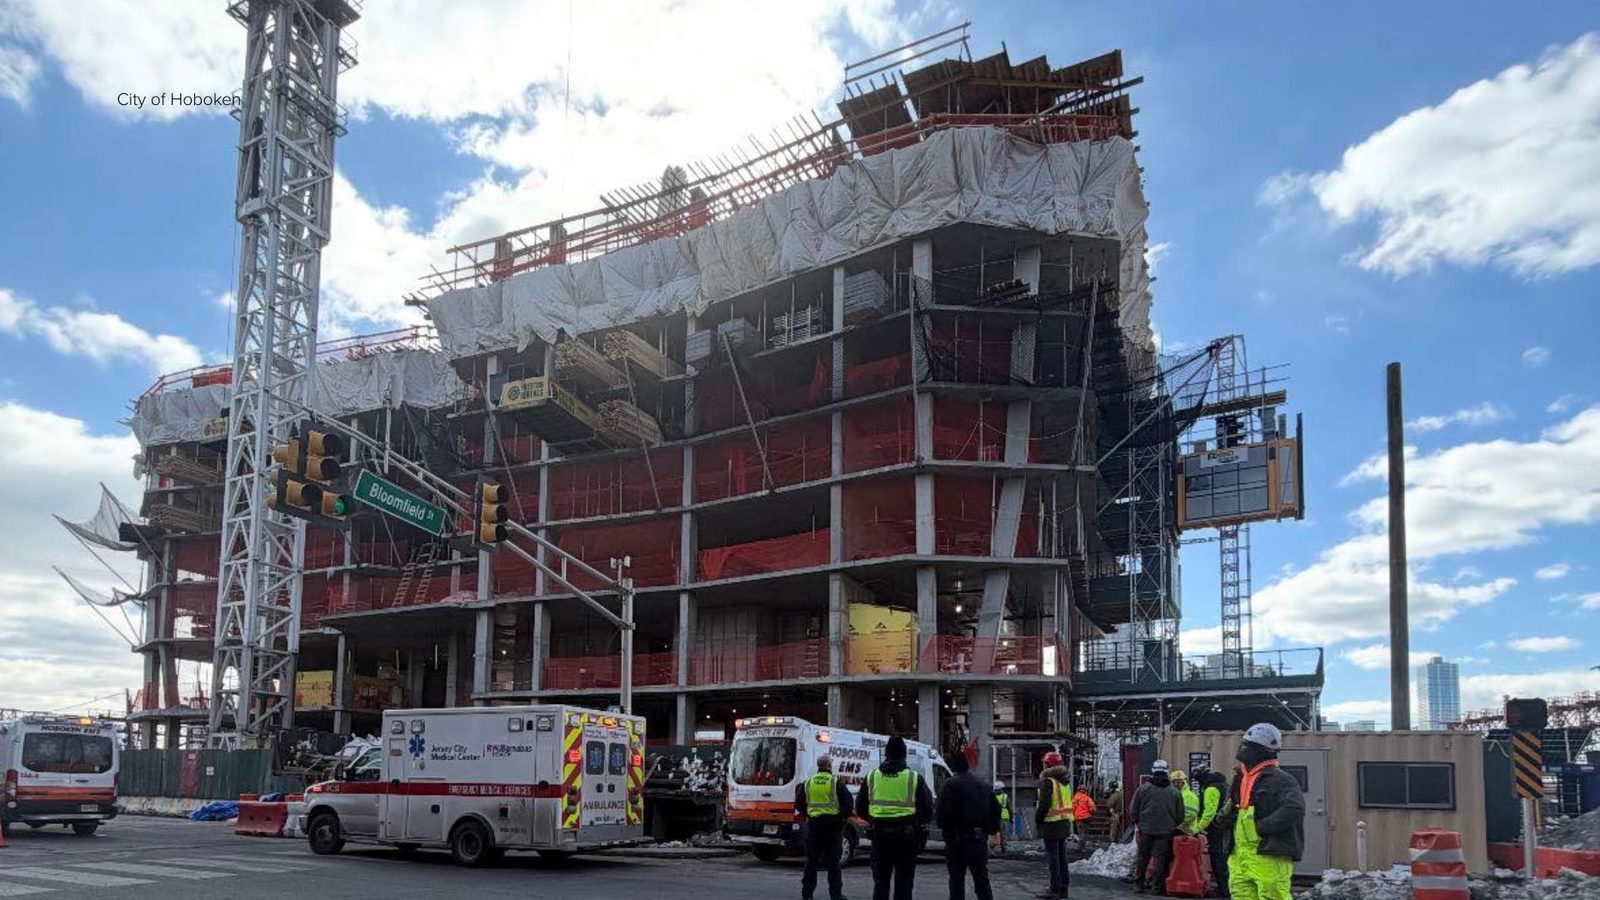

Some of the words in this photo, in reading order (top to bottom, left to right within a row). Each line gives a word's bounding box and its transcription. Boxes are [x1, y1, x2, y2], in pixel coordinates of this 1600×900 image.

[369, 482, 427, 520] Bloomfield
[431, 744, 453, 753] Jersey
[454, 744, 468, 753] City
[828, 745, 871, 761] HOBOKEN
[431, 752, 456, 761] Medical
[457, 753, 481, 761] Center
[838, 760, 862, 774] EMS
[448, 785, 479, 794] EMERGENCY
[479, 785, 503, 795] MEDICAL
[504, 786, 532, 796] SERVICES
[583, 800, 625, 810] AMBULANCE
